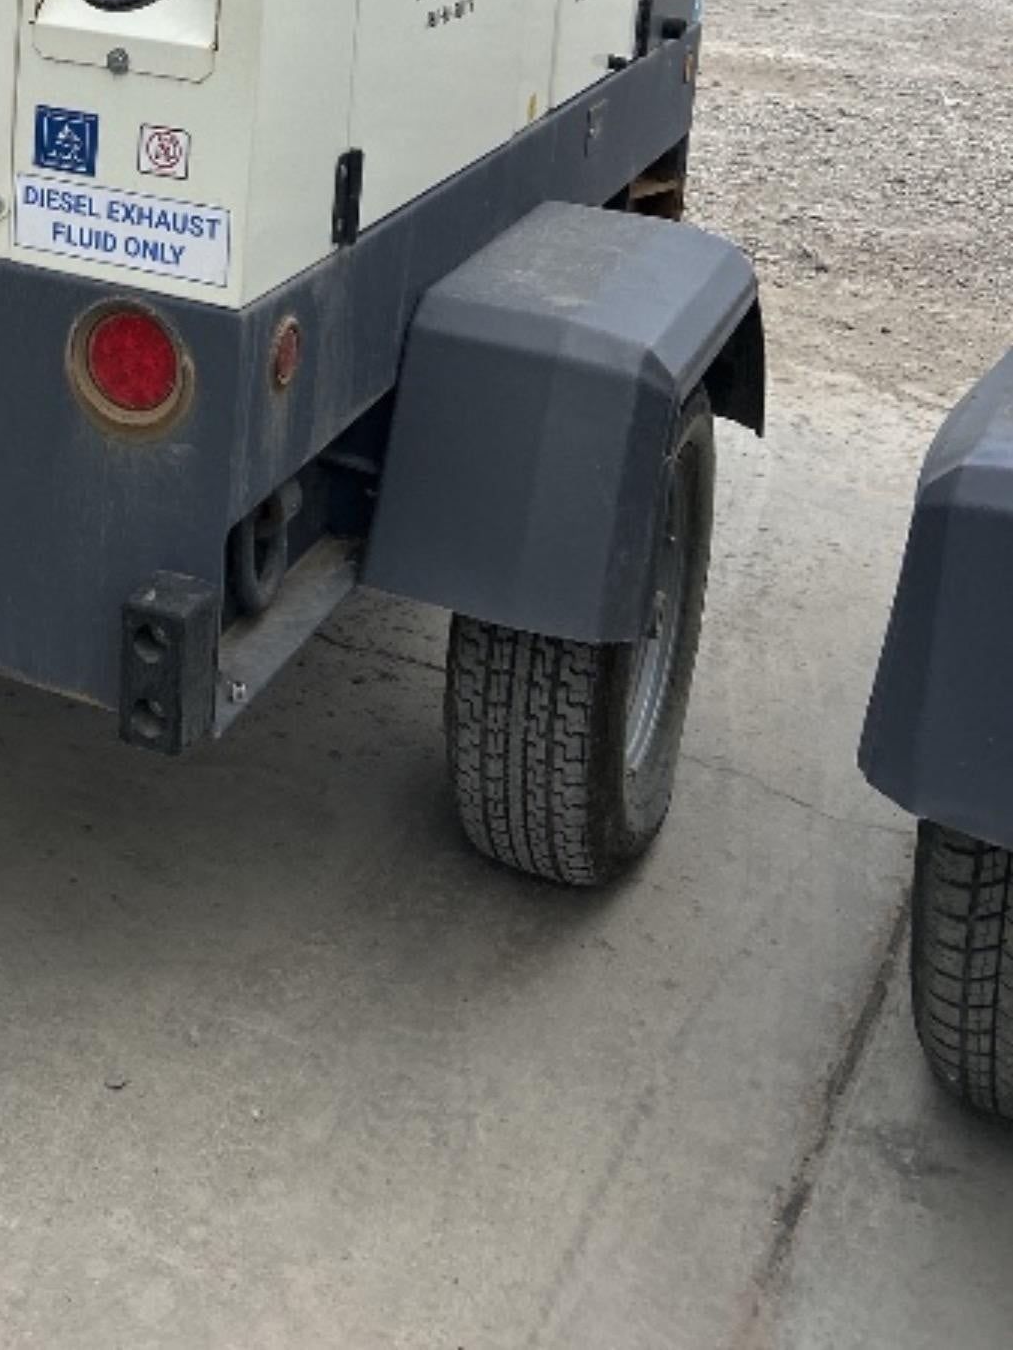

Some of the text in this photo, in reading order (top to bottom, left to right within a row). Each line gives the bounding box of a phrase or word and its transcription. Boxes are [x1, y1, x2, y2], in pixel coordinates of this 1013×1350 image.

[23, 184, 221, 240] DIESEL EXHAUST
[51, 221, 187, 266] FLUID ONLY
